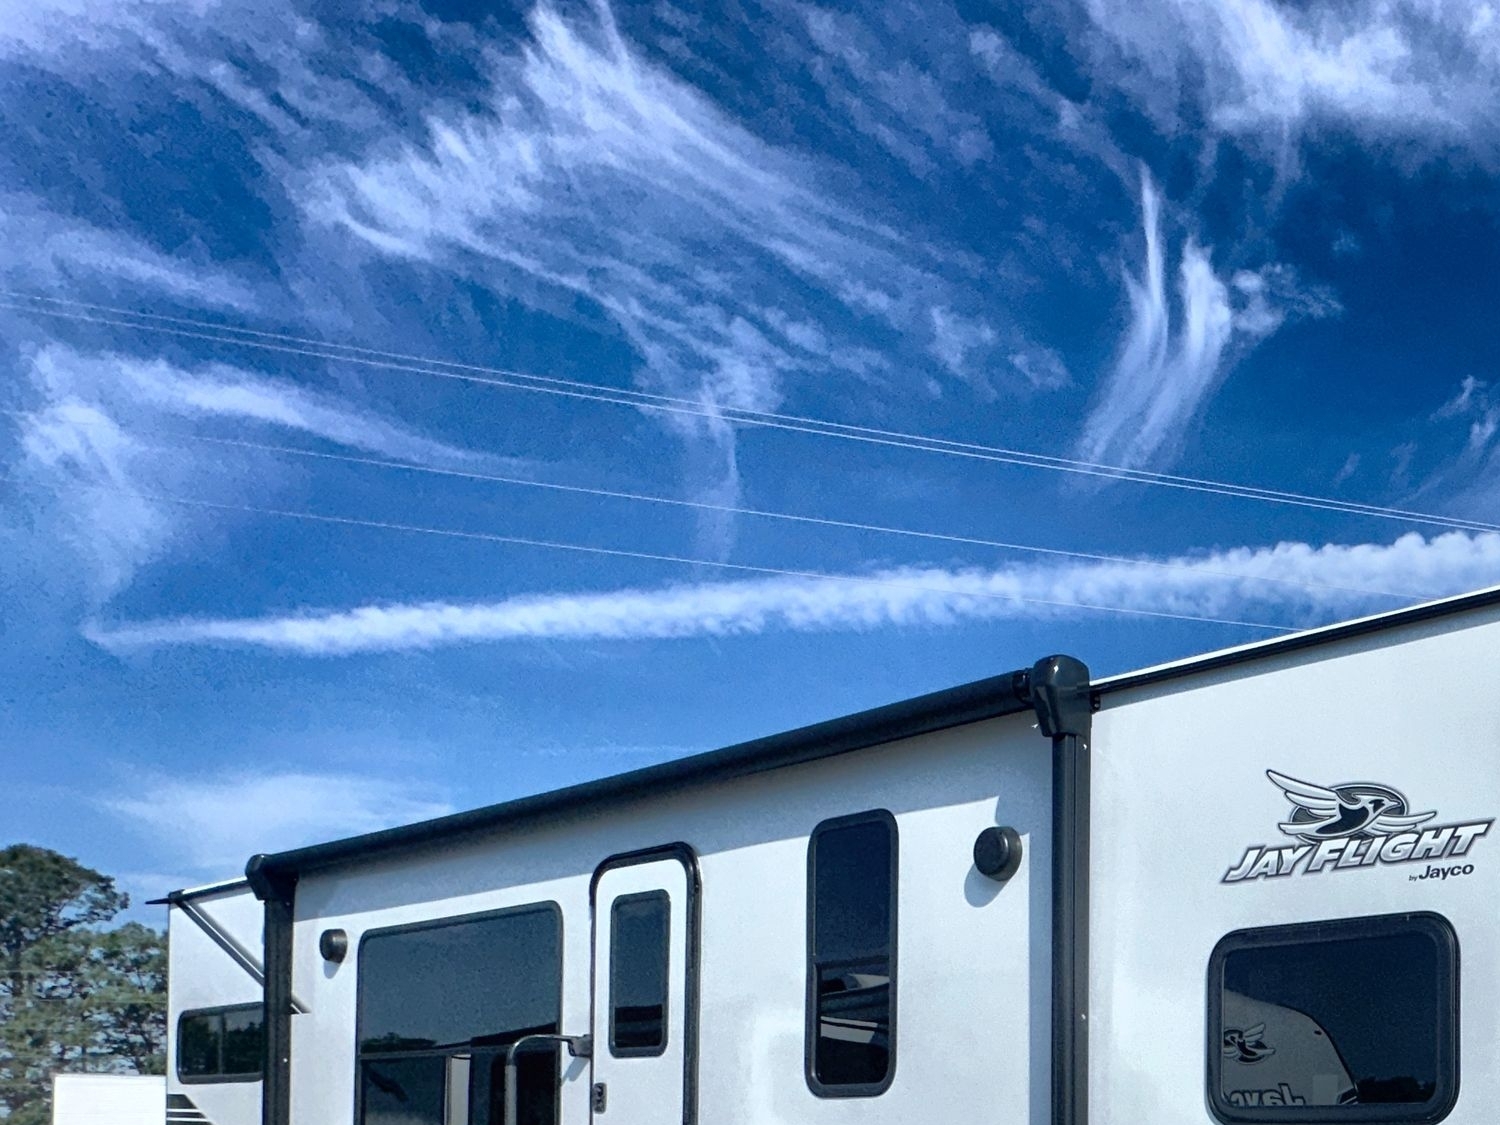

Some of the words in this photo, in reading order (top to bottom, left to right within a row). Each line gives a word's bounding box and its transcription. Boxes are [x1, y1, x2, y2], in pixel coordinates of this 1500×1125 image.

[1220, 845, 1312, 884] JAY
[1303, 818, 1496, 874] FLIGHT
[1418, 864, 1475, 881] Jayco
